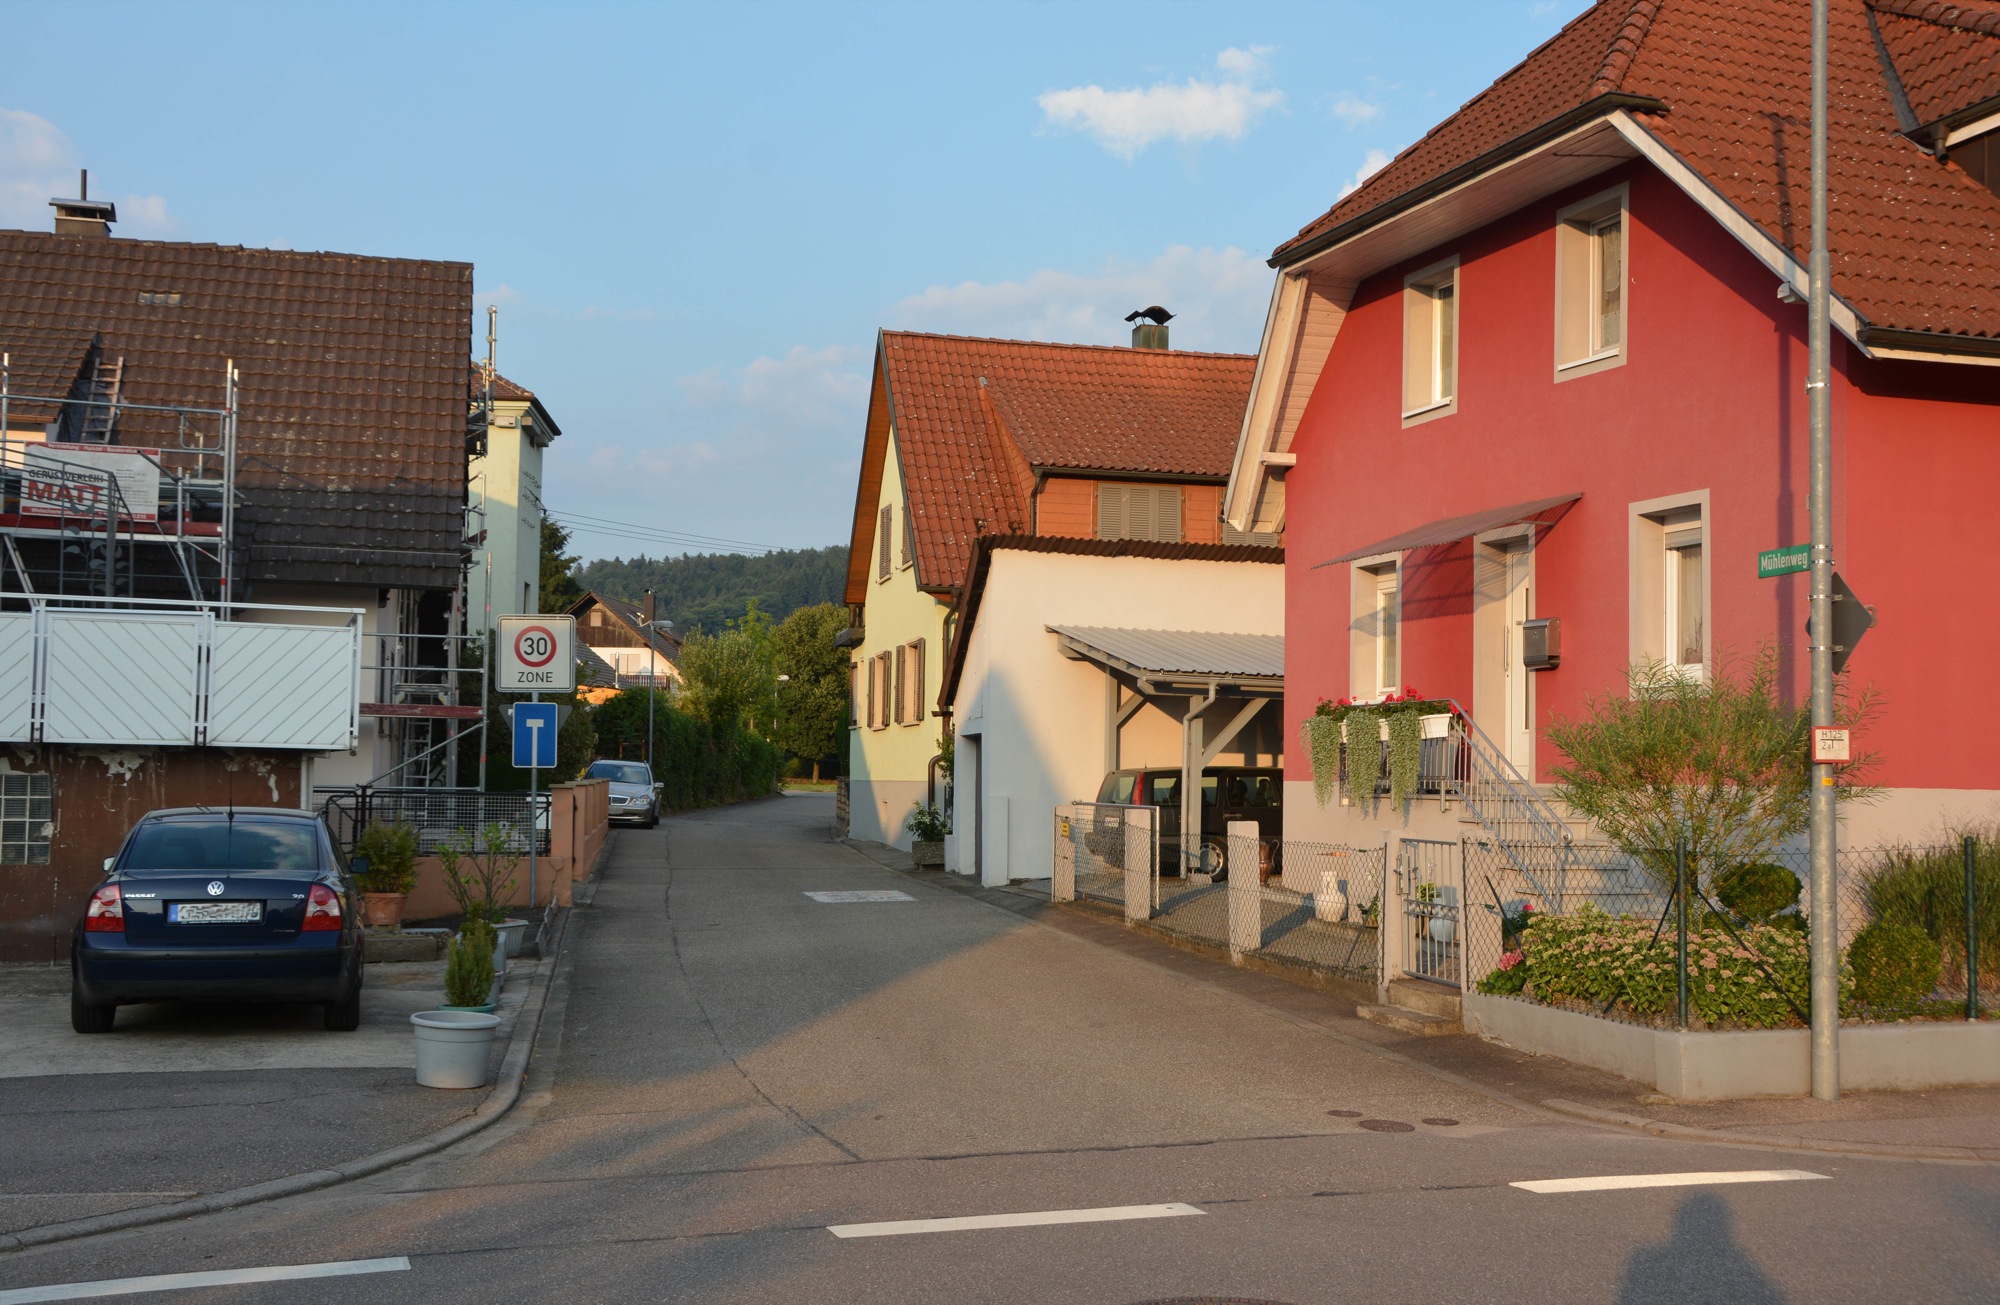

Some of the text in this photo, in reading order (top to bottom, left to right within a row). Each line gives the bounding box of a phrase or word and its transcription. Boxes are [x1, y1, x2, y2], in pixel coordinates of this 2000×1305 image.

[27, 480, 104, 503] MATT
[1761, 552, 1808, 571] Mühlenweg
[523, 637, 548, 656] 30
[517, 671, 553, 683] ZONE
